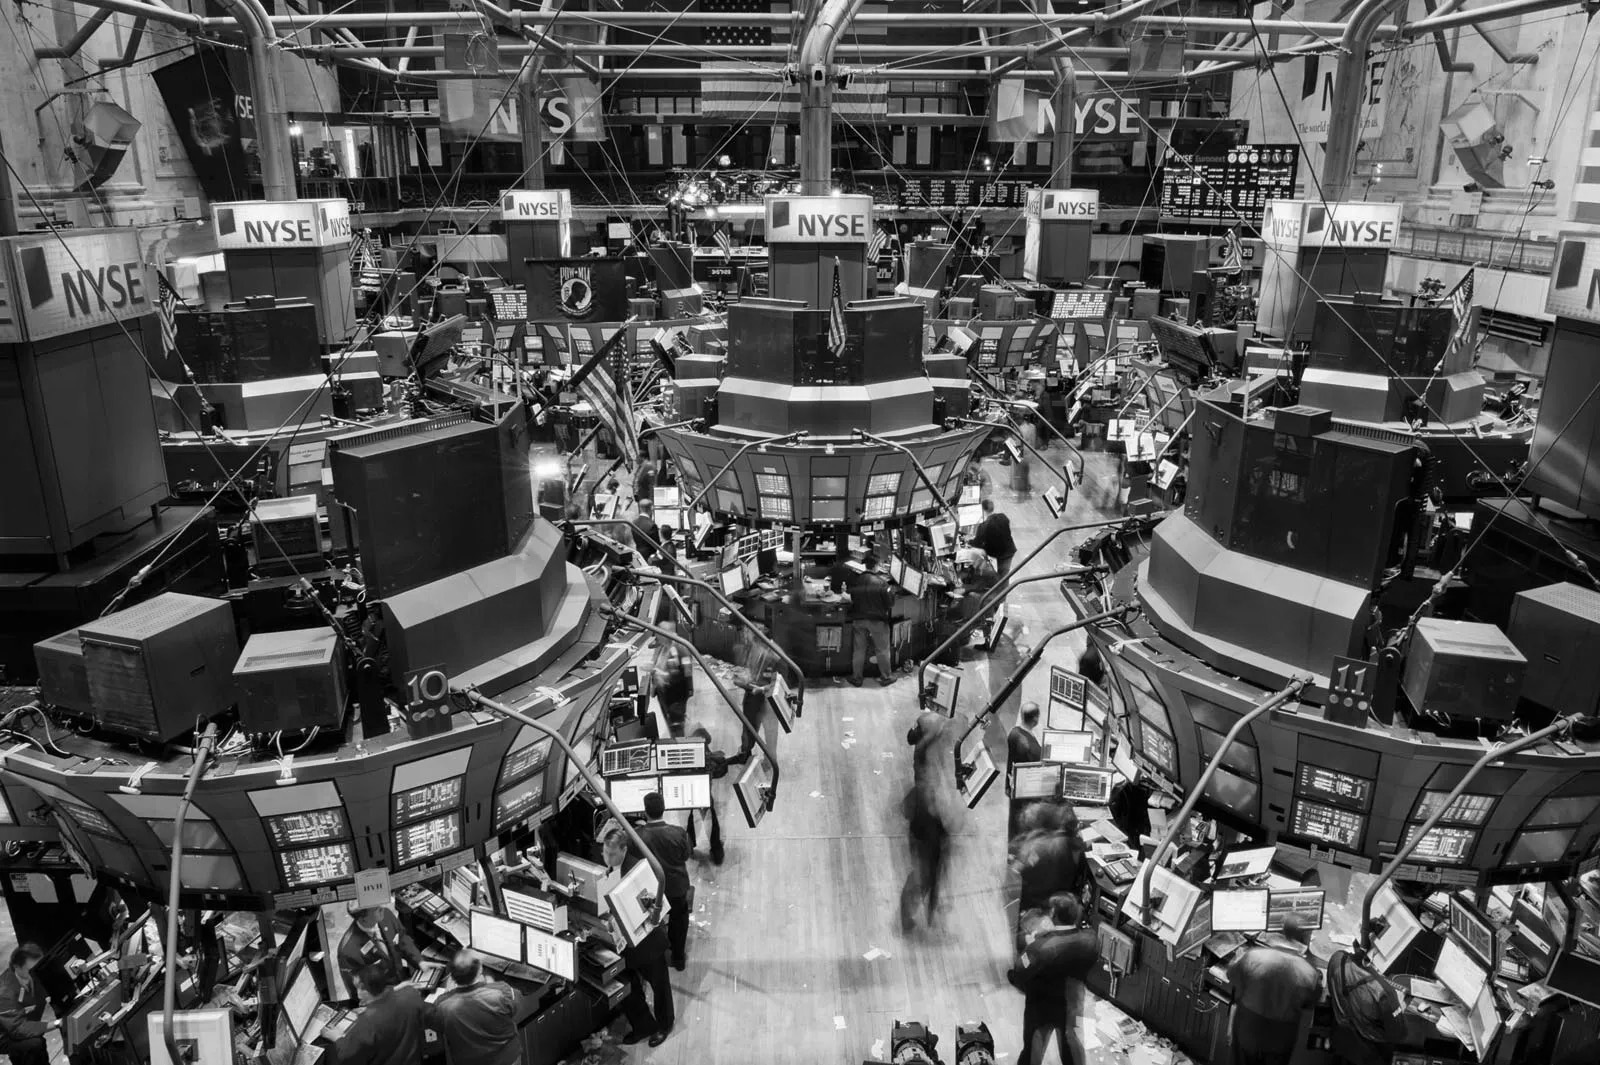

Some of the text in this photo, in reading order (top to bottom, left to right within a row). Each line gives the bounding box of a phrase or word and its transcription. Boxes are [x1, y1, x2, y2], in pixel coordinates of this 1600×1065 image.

[519, 202, 558, 216] NYSE
[1058, 202, 1096, 215] NYSE
[244, 219, 313, 243] NYSE
[330, 217, 350, 238] NYSE
[798, 214, 864, 237] NYSE
[1272, 218, 1300, 239] NYSE
[1331, 220, 1393, 243] NYSE
[61, 262, 145, 318] NYSE
[408, 671, 447, 706] 10
[1335, 664, 1367, 696] 11
